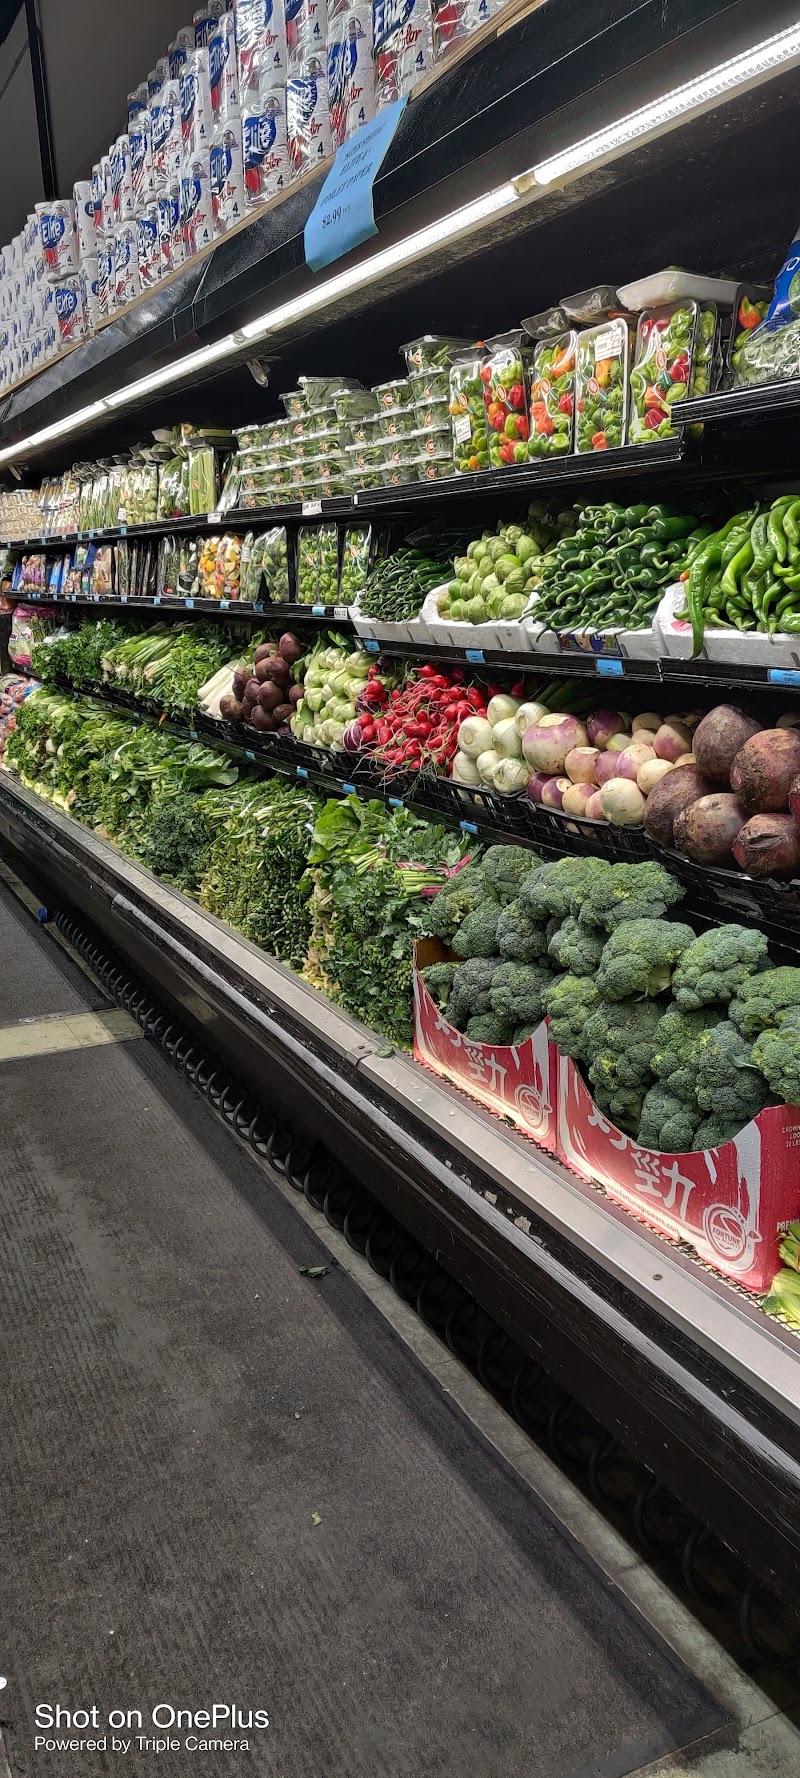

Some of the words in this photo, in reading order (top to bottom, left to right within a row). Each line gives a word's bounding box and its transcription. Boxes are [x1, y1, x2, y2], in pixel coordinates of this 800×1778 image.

[313, 21, 321, 35] 4
[273, 51, 281, 64] 4
[415, 50, 424, 66] 4
[230, 89, 237, 101] 4
[358, 106, 366, 120] 4
[199, 123, 205, 134] 4
[317, 141, 324, 155] 4
[174, 154, 181, 165] 4
[276, 174, 284, 187] 4
[232, 201, 239, 213] 4
[321, 205, 342, 231] $2.99
[203, 228, 209, 239] 4
[66, 255, 72, 263] 4
[712, 1226, 741, 1247] FORTUNE
